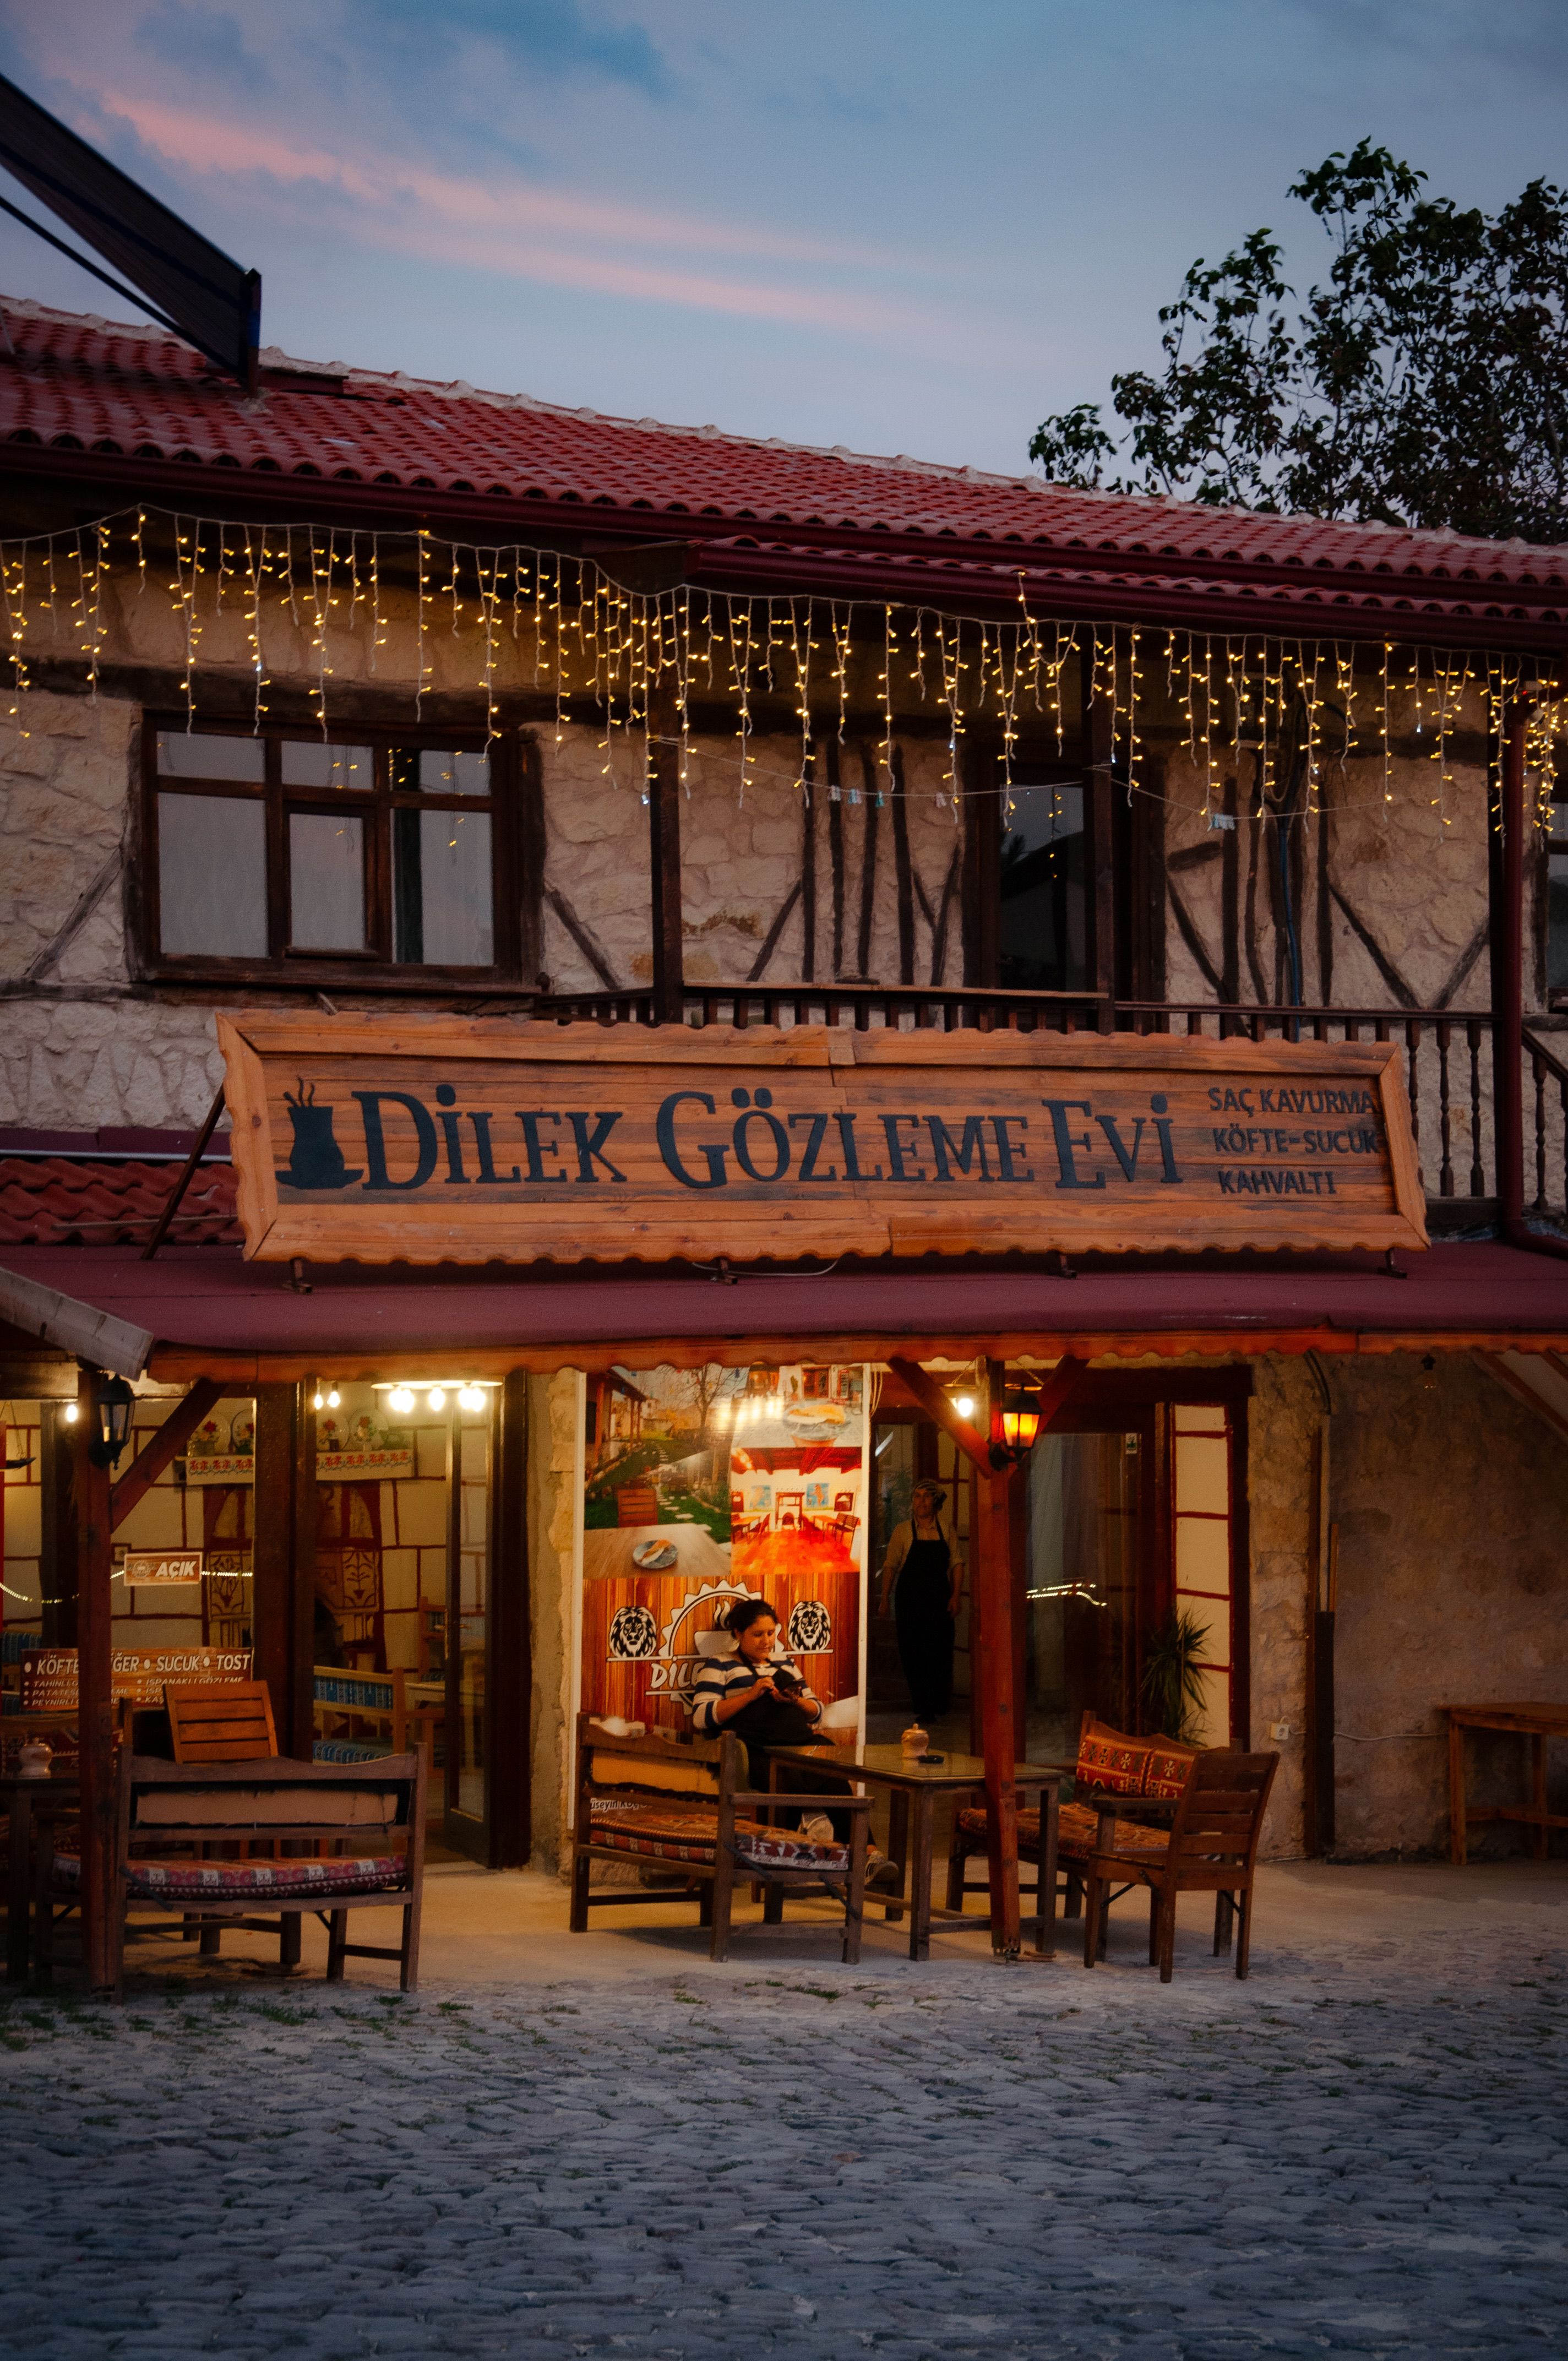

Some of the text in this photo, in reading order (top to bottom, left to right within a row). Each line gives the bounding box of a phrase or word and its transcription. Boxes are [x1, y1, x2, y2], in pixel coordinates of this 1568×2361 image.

[1208, 1086, 1377, 1118] SAÇ KAVURMA
[351, 1084, 1183, 1189] DİLEK GÖZLEME EVİ
[1213, 1123, 1380, 1154] KÖFTE-SUCUK
[1218, 1170, 1337, 1194] KAHVALTI
[155, 1560, 197, 1580] AÇIK
[36, 1653, 79, 1675] KÖFTE
[156, 1655, 201, 1672] SUCUK
[216, 1654, 252, 1671] TOST
